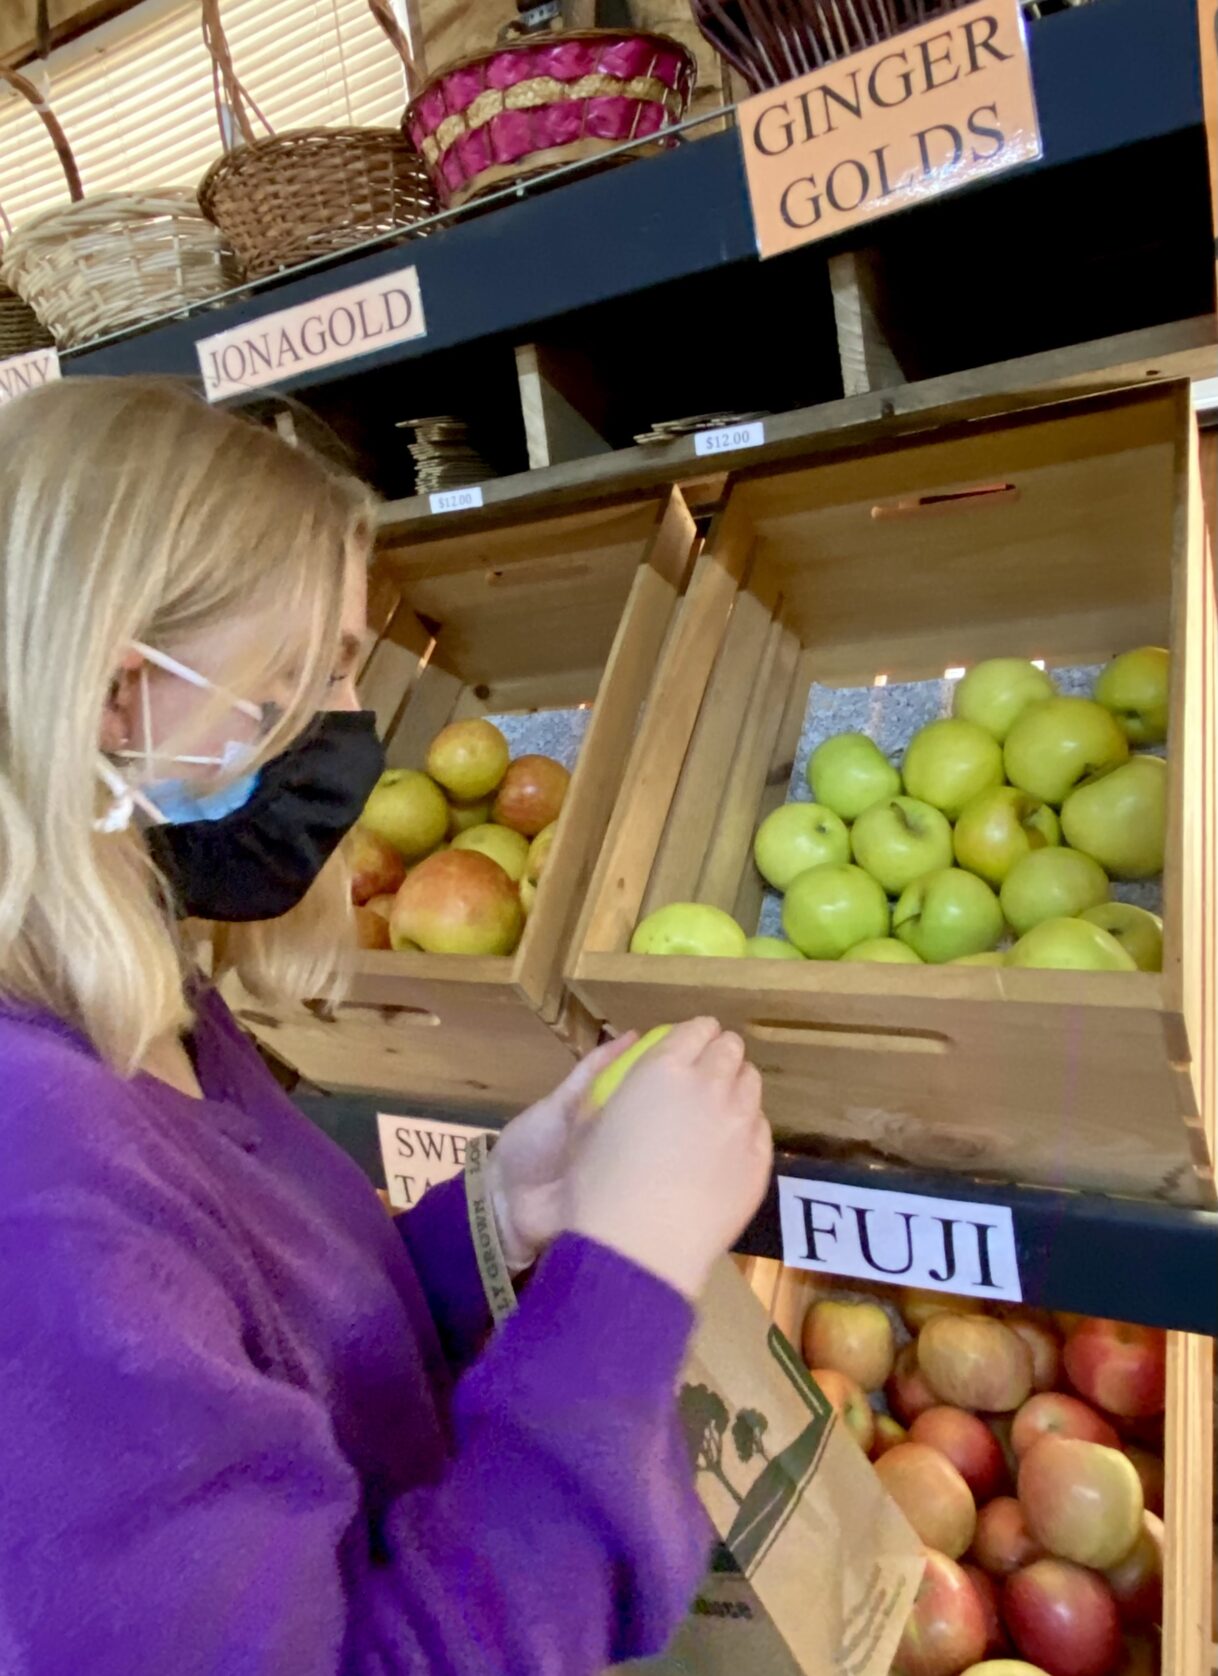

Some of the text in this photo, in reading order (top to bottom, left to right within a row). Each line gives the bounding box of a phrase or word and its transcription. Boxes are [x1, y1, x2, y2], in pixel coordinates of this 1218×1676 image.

[753, 15, 1014, 156] GINGER
[780, 102, 1005, 229] GOLDS
[210, 289, 412, 388] JONAGOLD
[705, 430, 750, 449] $12.00
[438, 493, 473, 509] $12.00
[473, 1199, 500, 1278] GROWN
[793, 1196, 1004, 1289] FUJI
